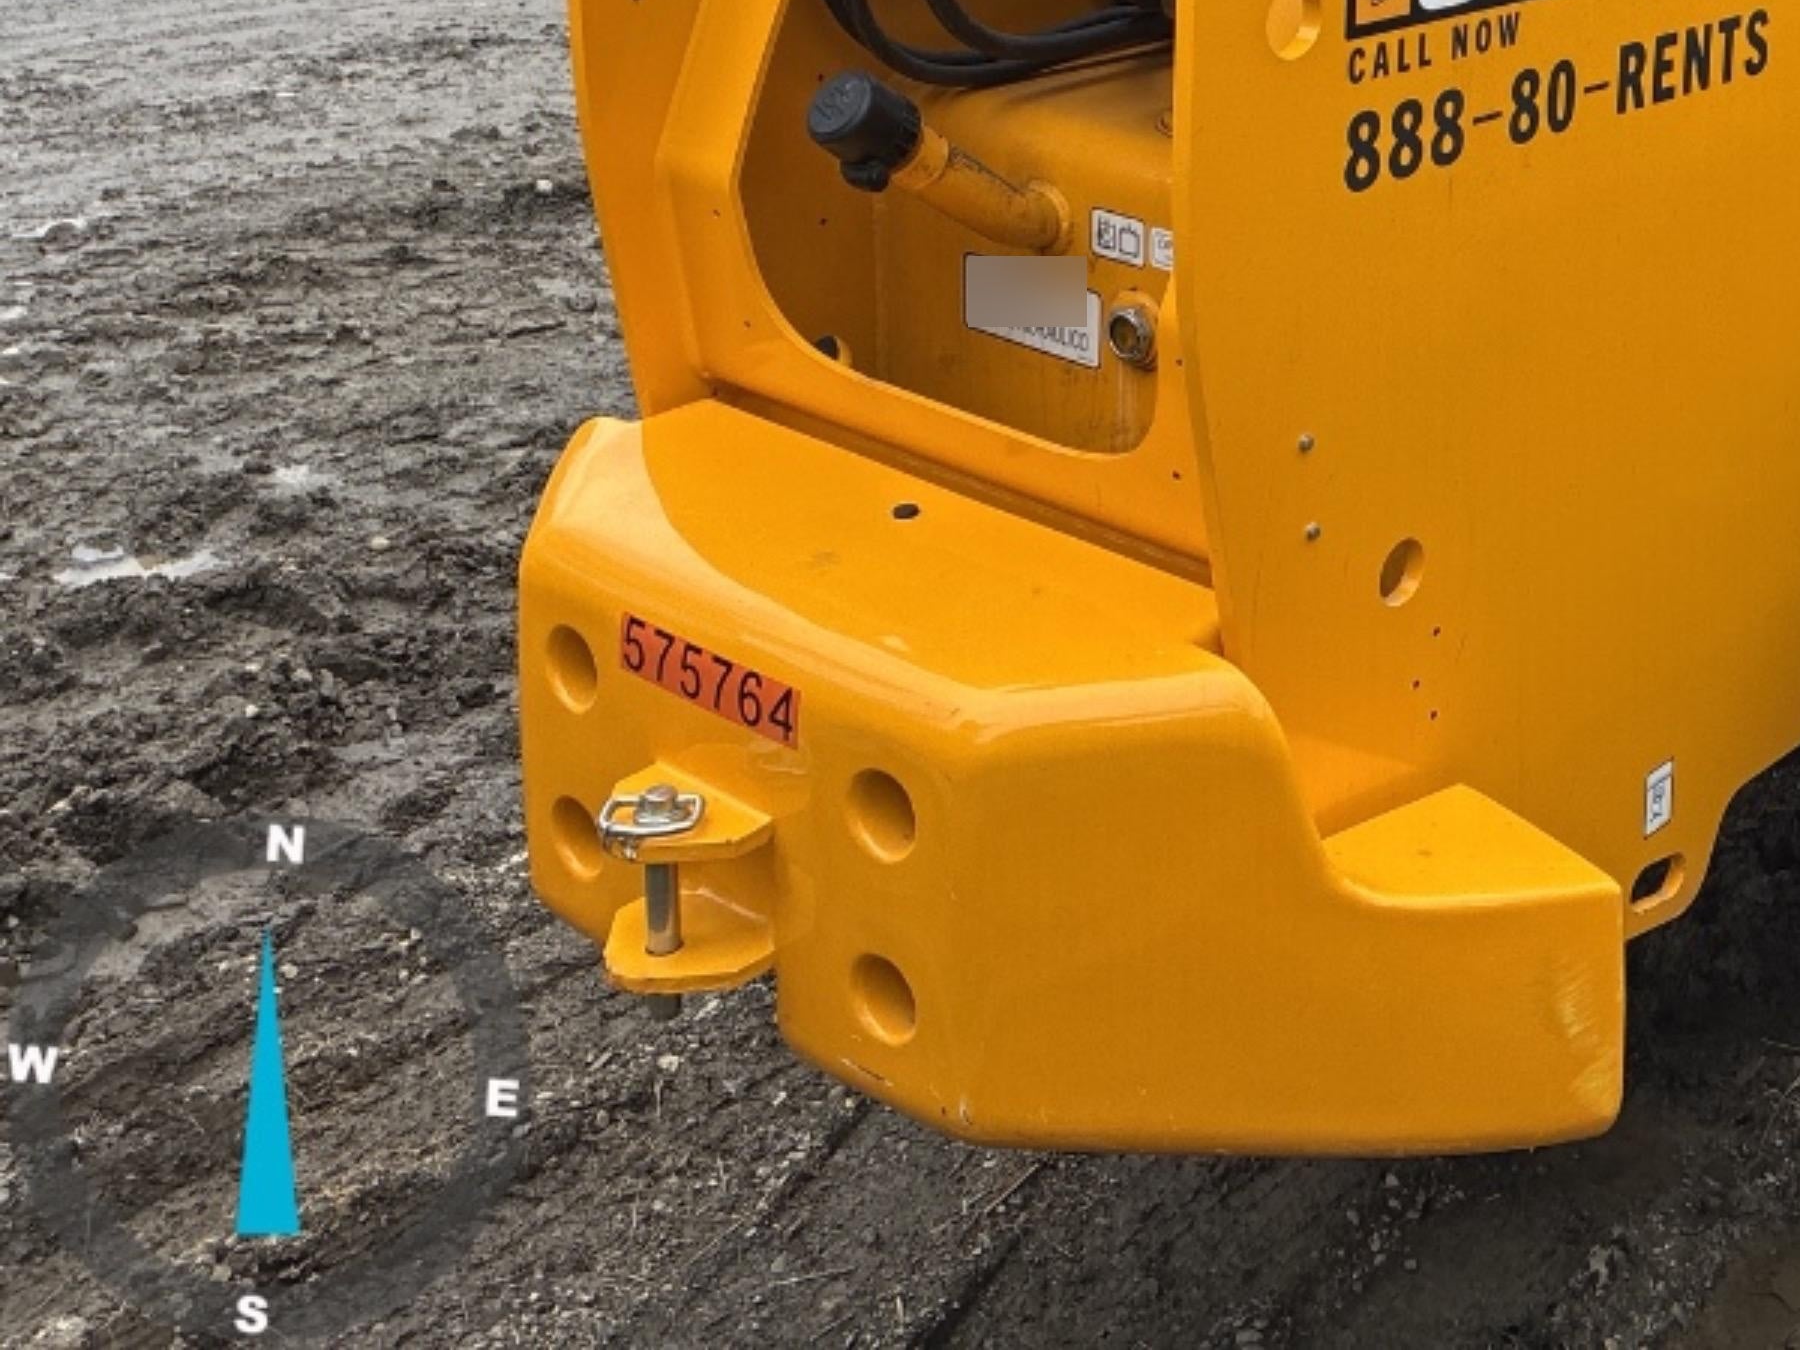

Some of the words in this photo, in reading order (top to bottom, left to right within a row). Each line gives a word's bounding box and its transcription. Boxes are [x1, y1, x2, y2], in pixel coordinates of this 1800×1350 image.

[1343, 8, 1770, 193] 888-80-RENTS
[1347, 32, 1433, 85] CALL
[1451, 12, 1522, 60] NOW
[623, 615, 794, 742] 575764
